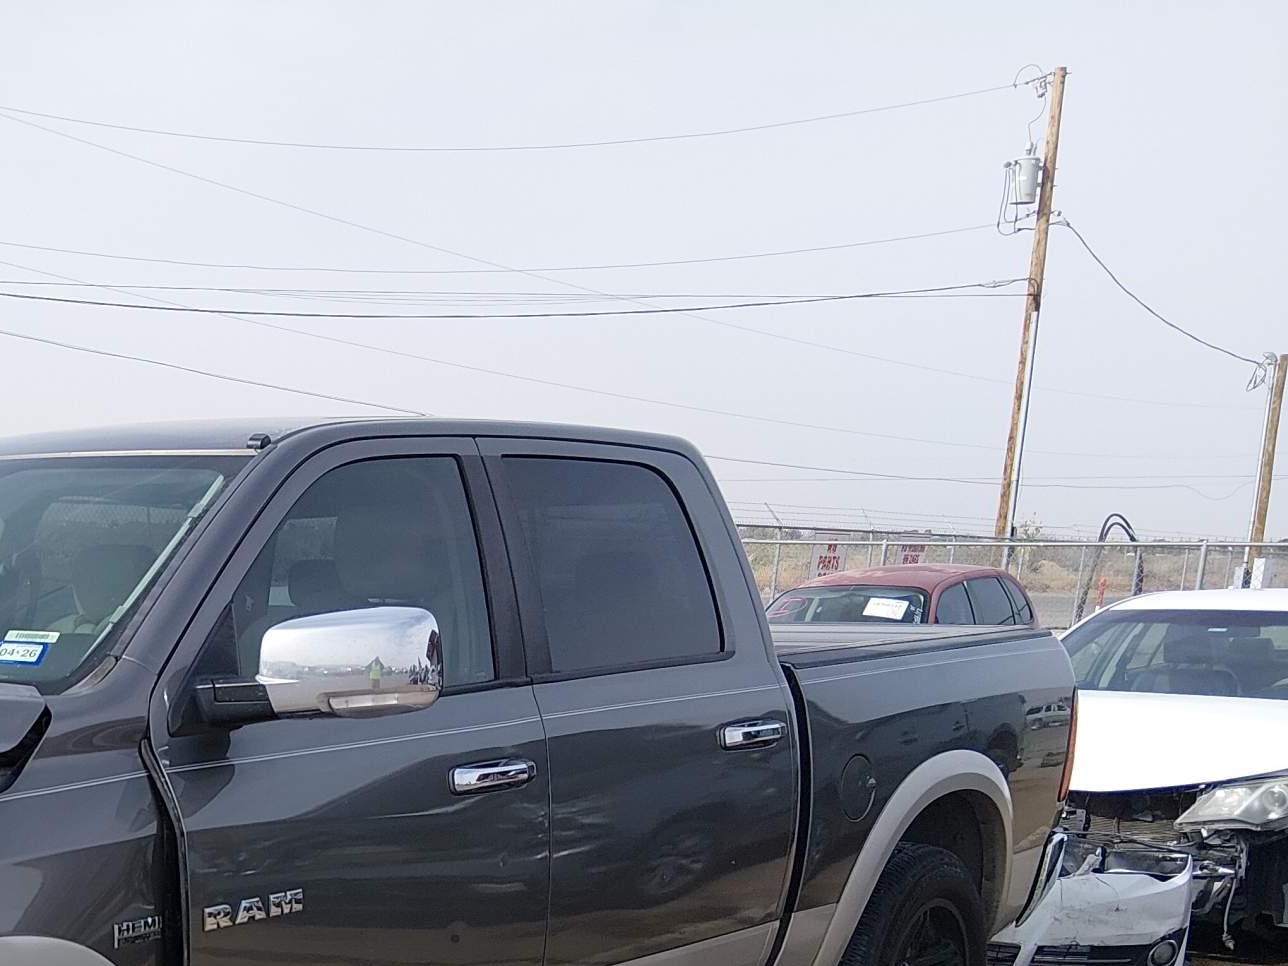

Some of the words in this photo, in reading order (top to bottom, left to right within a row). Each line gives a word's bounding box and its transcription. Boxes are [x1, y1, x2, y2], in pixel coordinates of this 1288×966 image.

[817, 555, 841, 571] PARTS
[203, 888, 304, 932] RAM
[113, 915, 162, 949] HEMI
